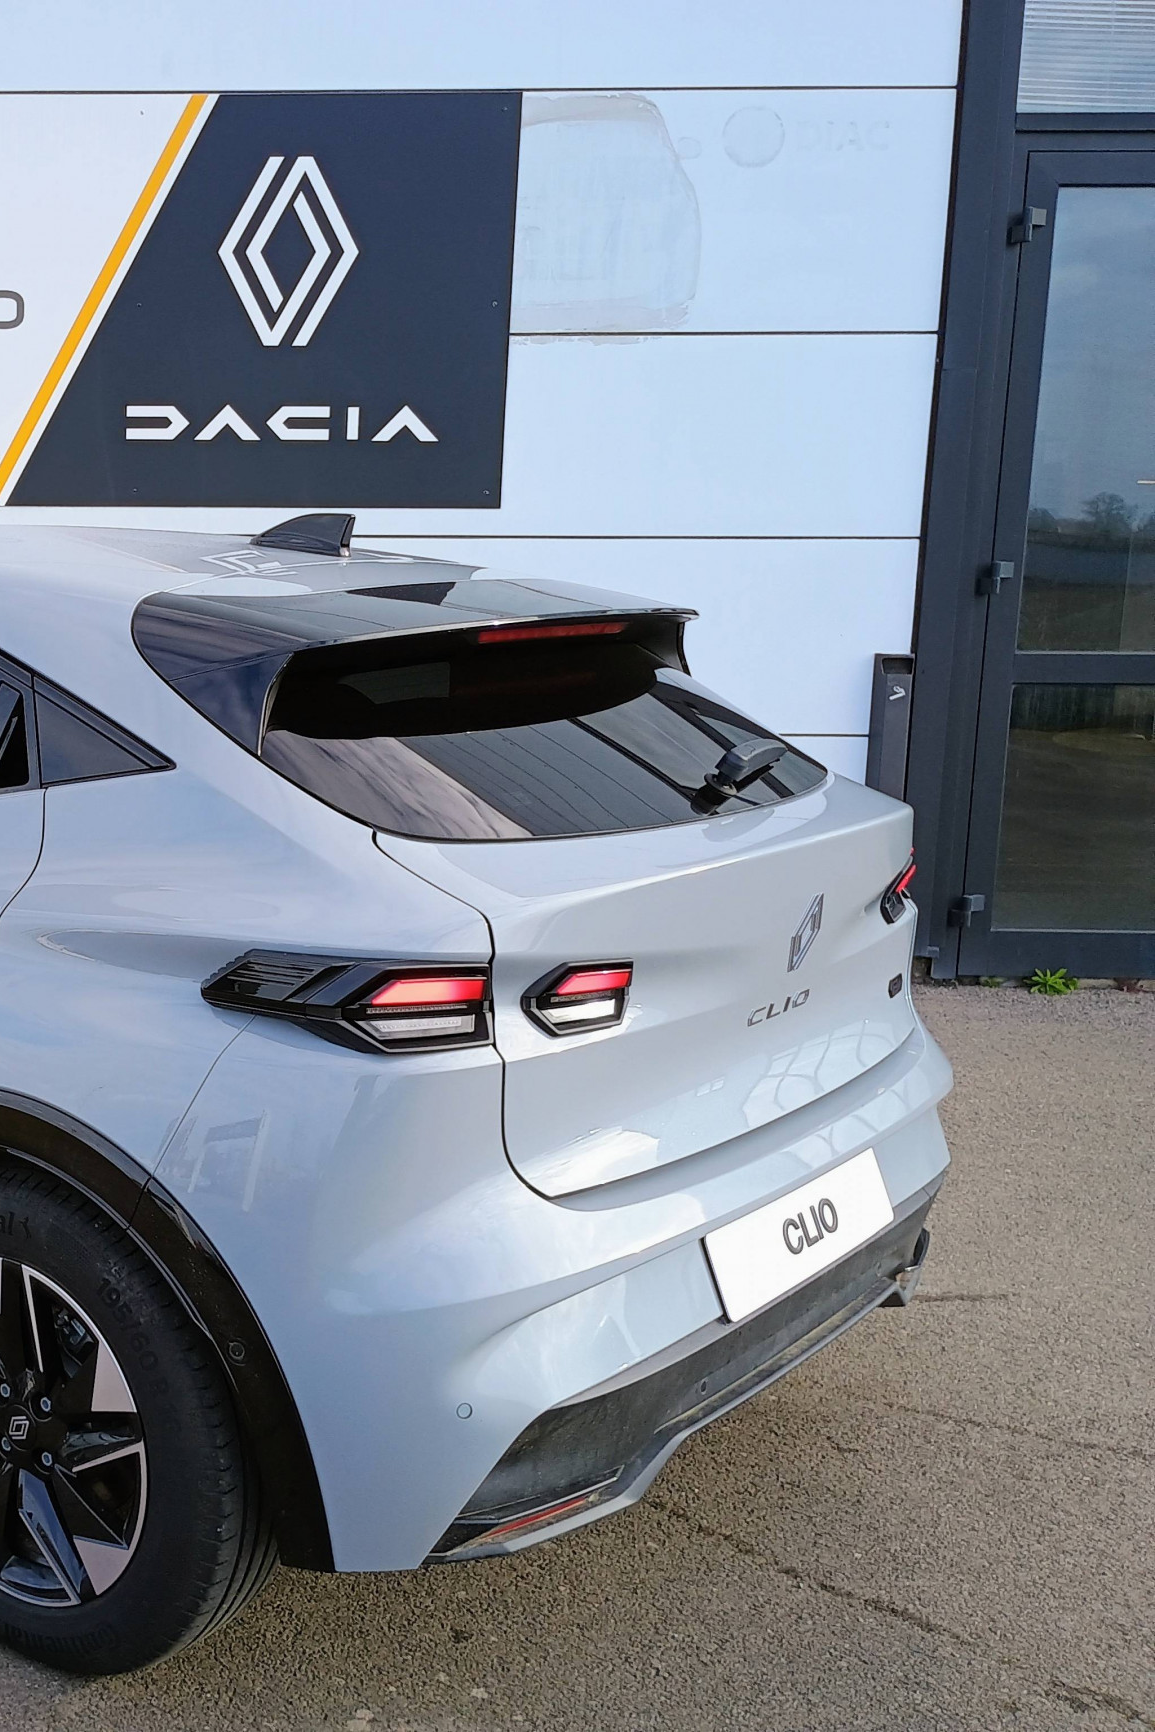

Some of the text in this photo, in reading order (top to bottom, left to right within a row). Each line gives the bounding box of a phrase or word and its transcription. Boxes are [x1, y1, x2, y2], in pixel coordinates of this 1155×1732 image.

[125, 404, 439, 442] DACIA
[747, 989, 810, 1027] CLIO
[782, 1198, 839, 1255] CLIO
